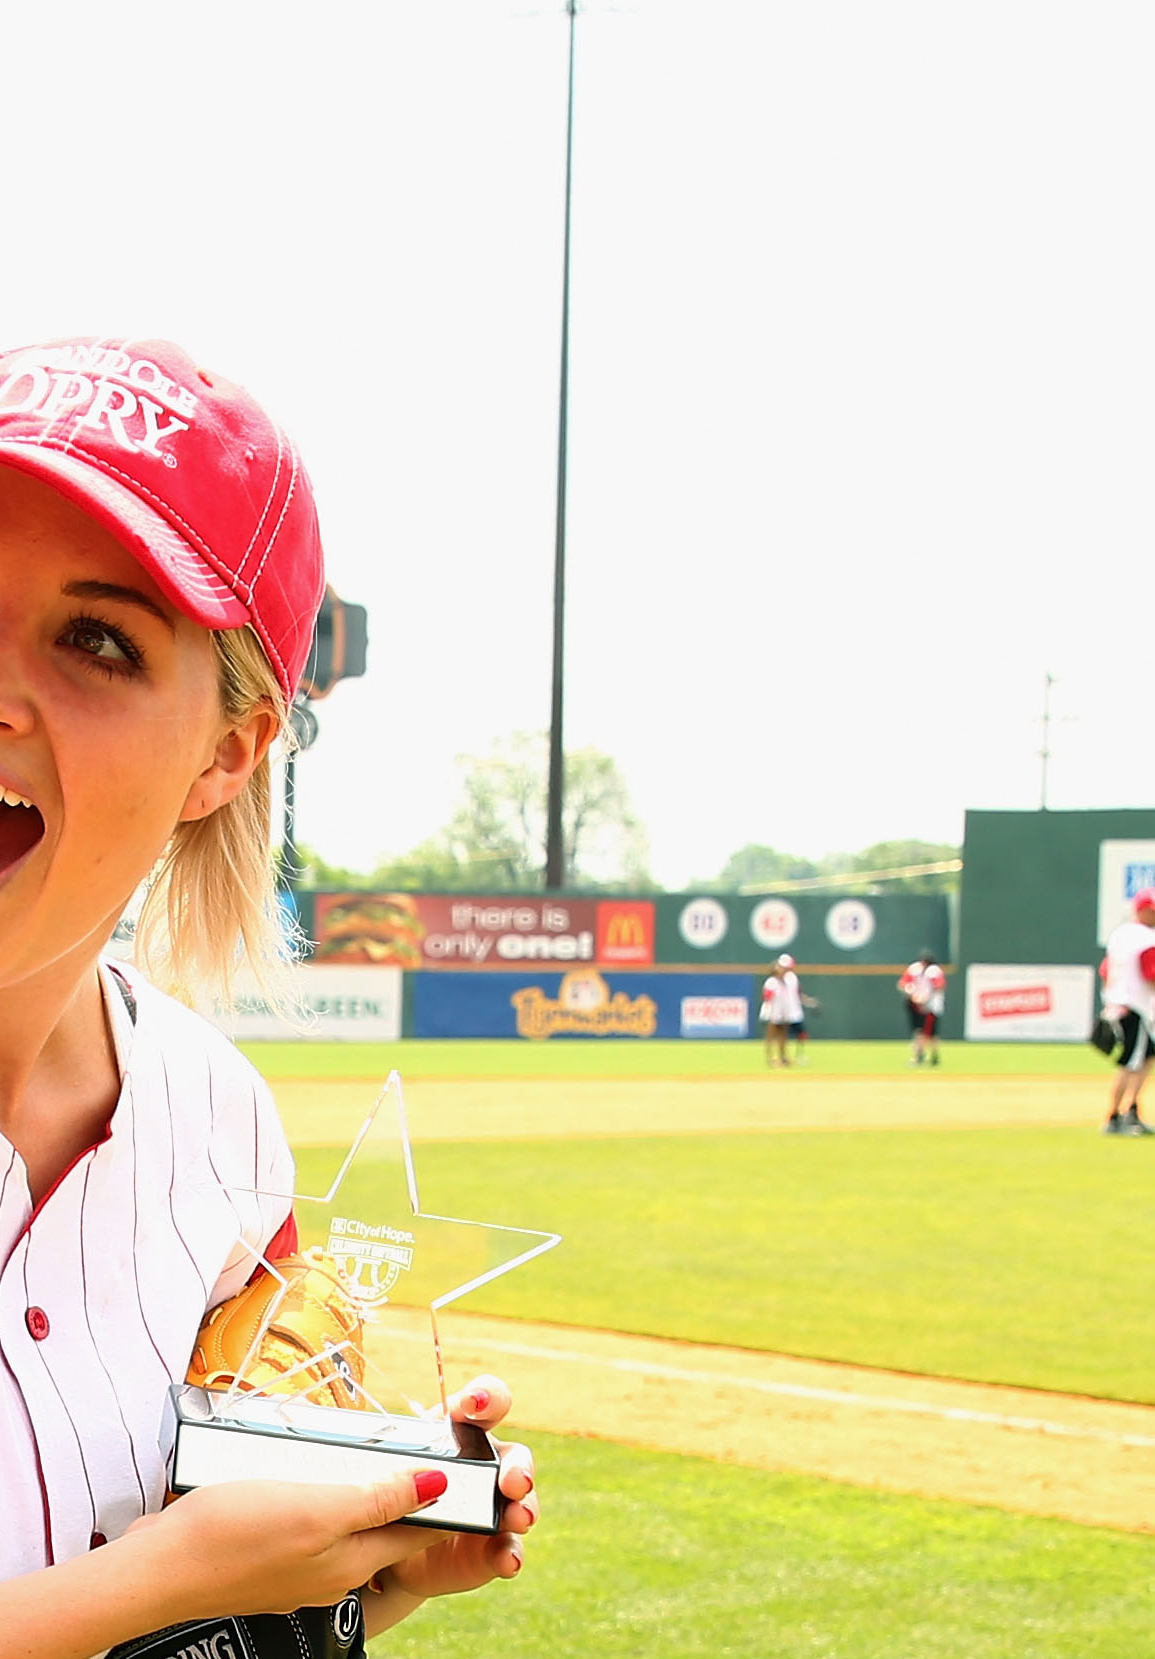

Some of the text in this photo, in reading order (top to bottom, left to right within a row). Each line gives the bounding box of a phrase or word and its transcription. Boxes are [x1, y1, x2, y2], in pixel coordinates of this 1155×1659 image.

[450, 901, 571, 932] there is
[423, 930, 494, 964] only
[496, 930, 594, 960] one!
[346, 1219, 371, 1239] City
